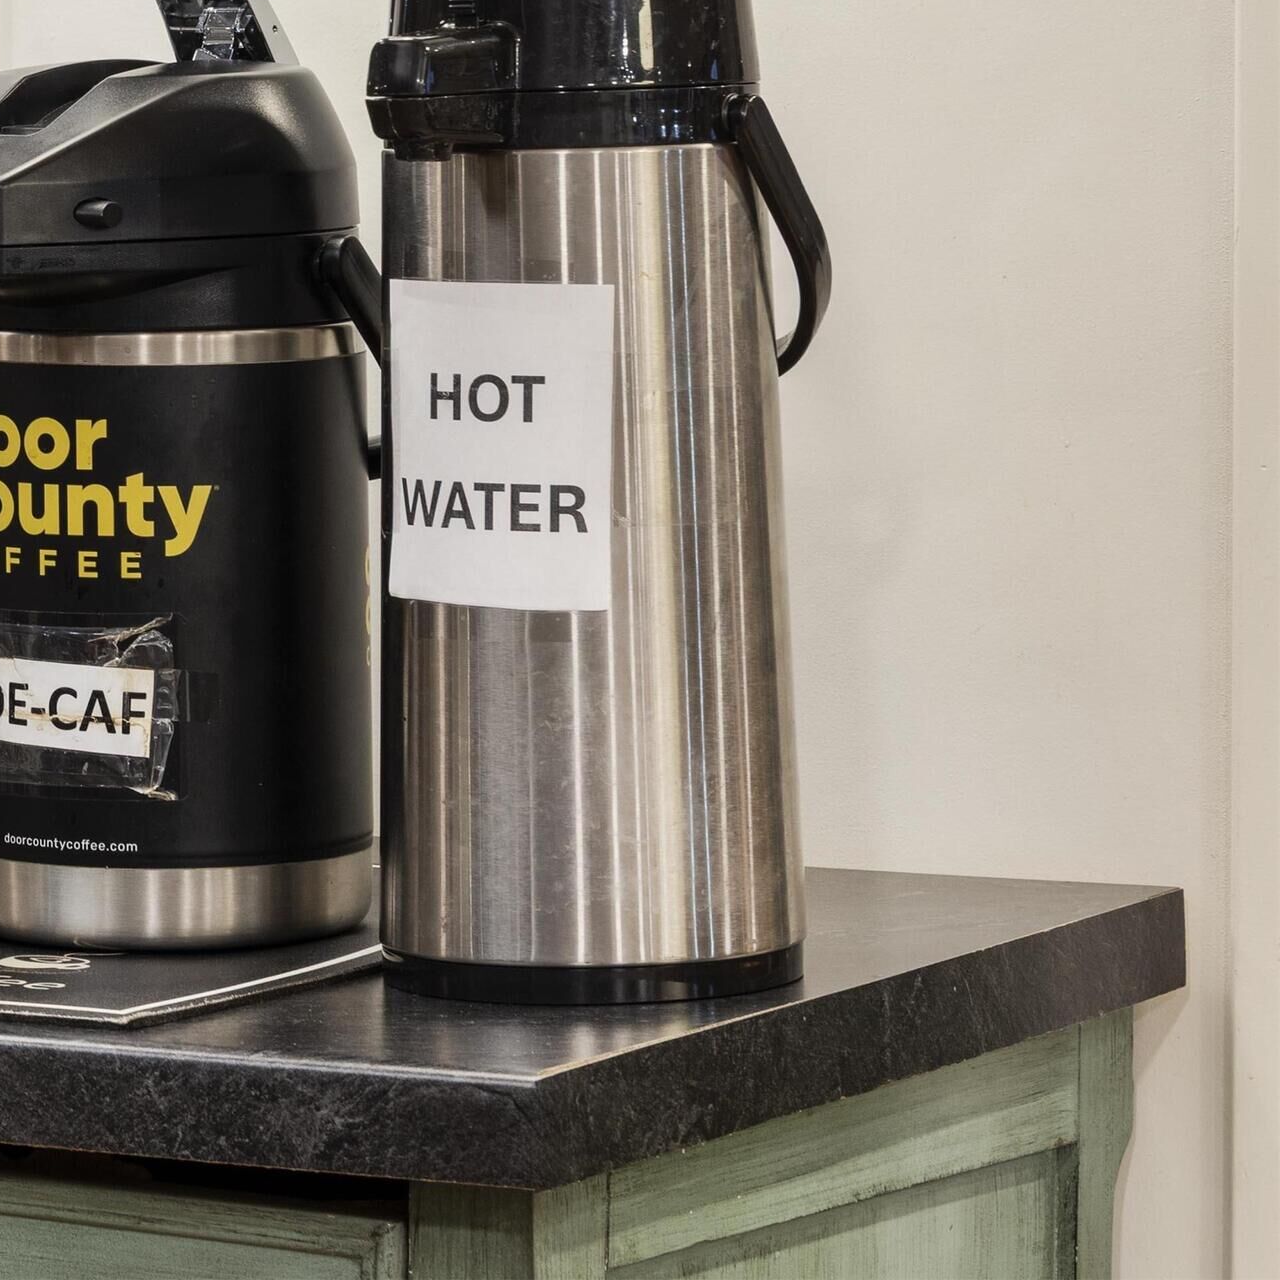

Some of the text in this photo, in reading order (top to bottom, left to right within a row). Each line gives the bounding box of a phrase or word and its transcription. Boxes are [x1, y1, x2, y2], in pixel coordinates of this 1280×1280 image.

[430, 372, 546, 423] HOT
[401, 477, 589, 534] WATER
[4, 833, 139, 853] doorcountycoffee.com
